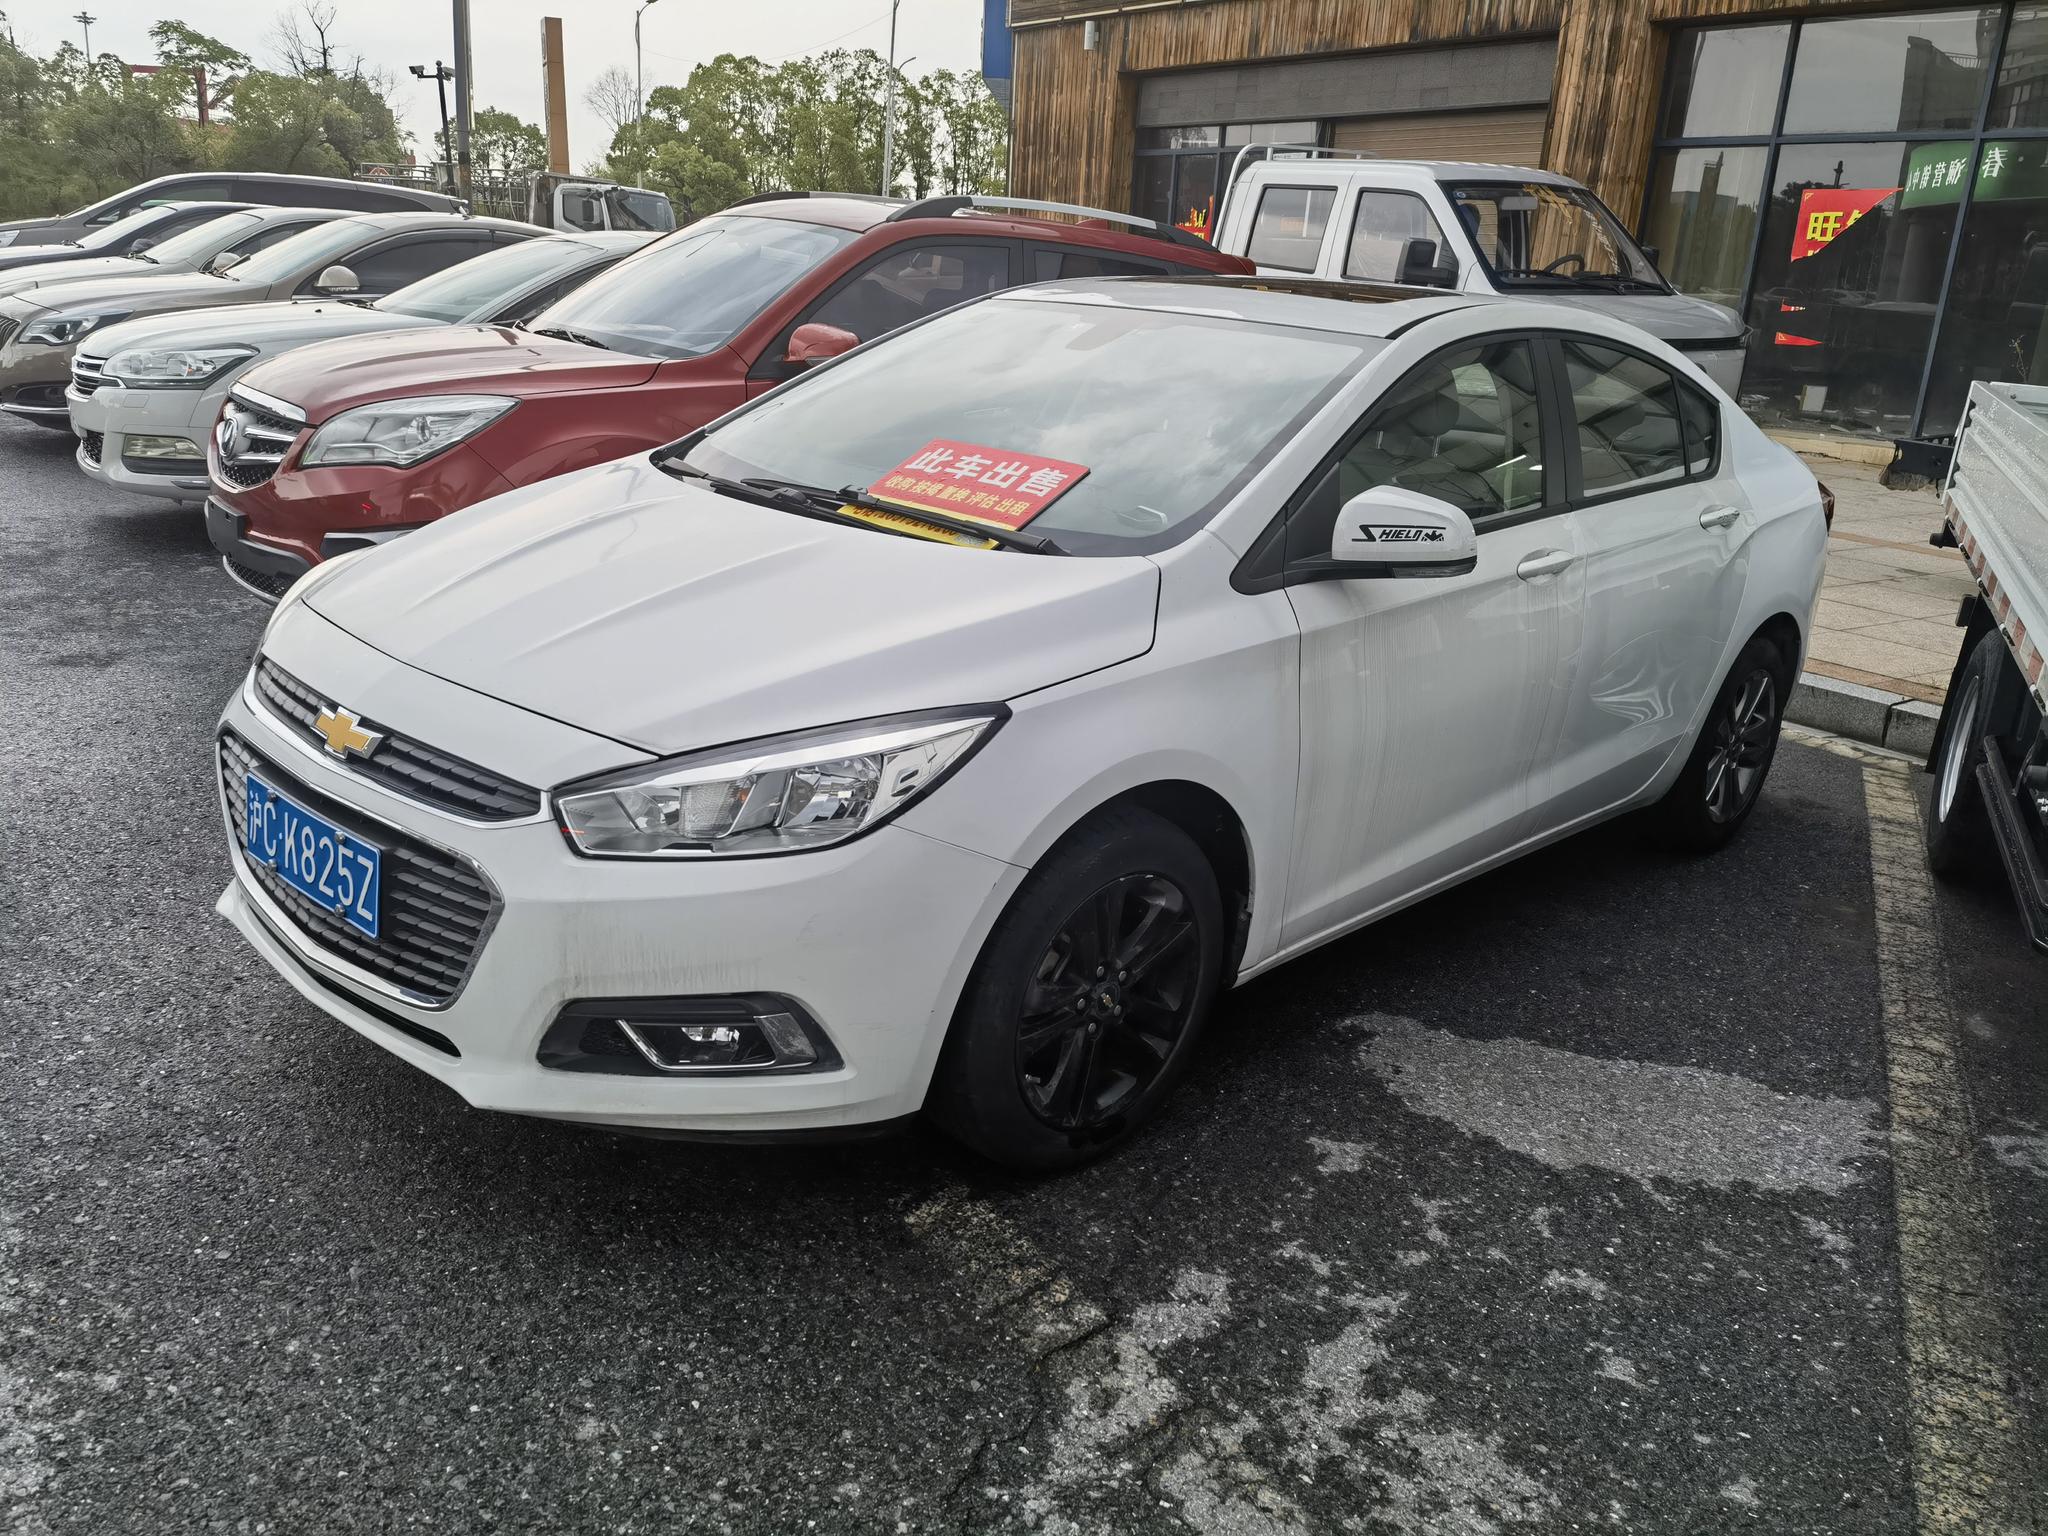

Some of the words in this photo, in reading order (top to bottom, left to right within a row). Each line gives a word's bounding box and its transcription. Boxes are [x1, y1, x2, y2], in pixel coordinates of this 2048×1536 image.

[1806, 209, 1863, 242] 旺
[904, 446, 1069, 498] 此车出售
[967, 491, 1000, 510] 评估
[994, 499, 1032, 517] 出租
